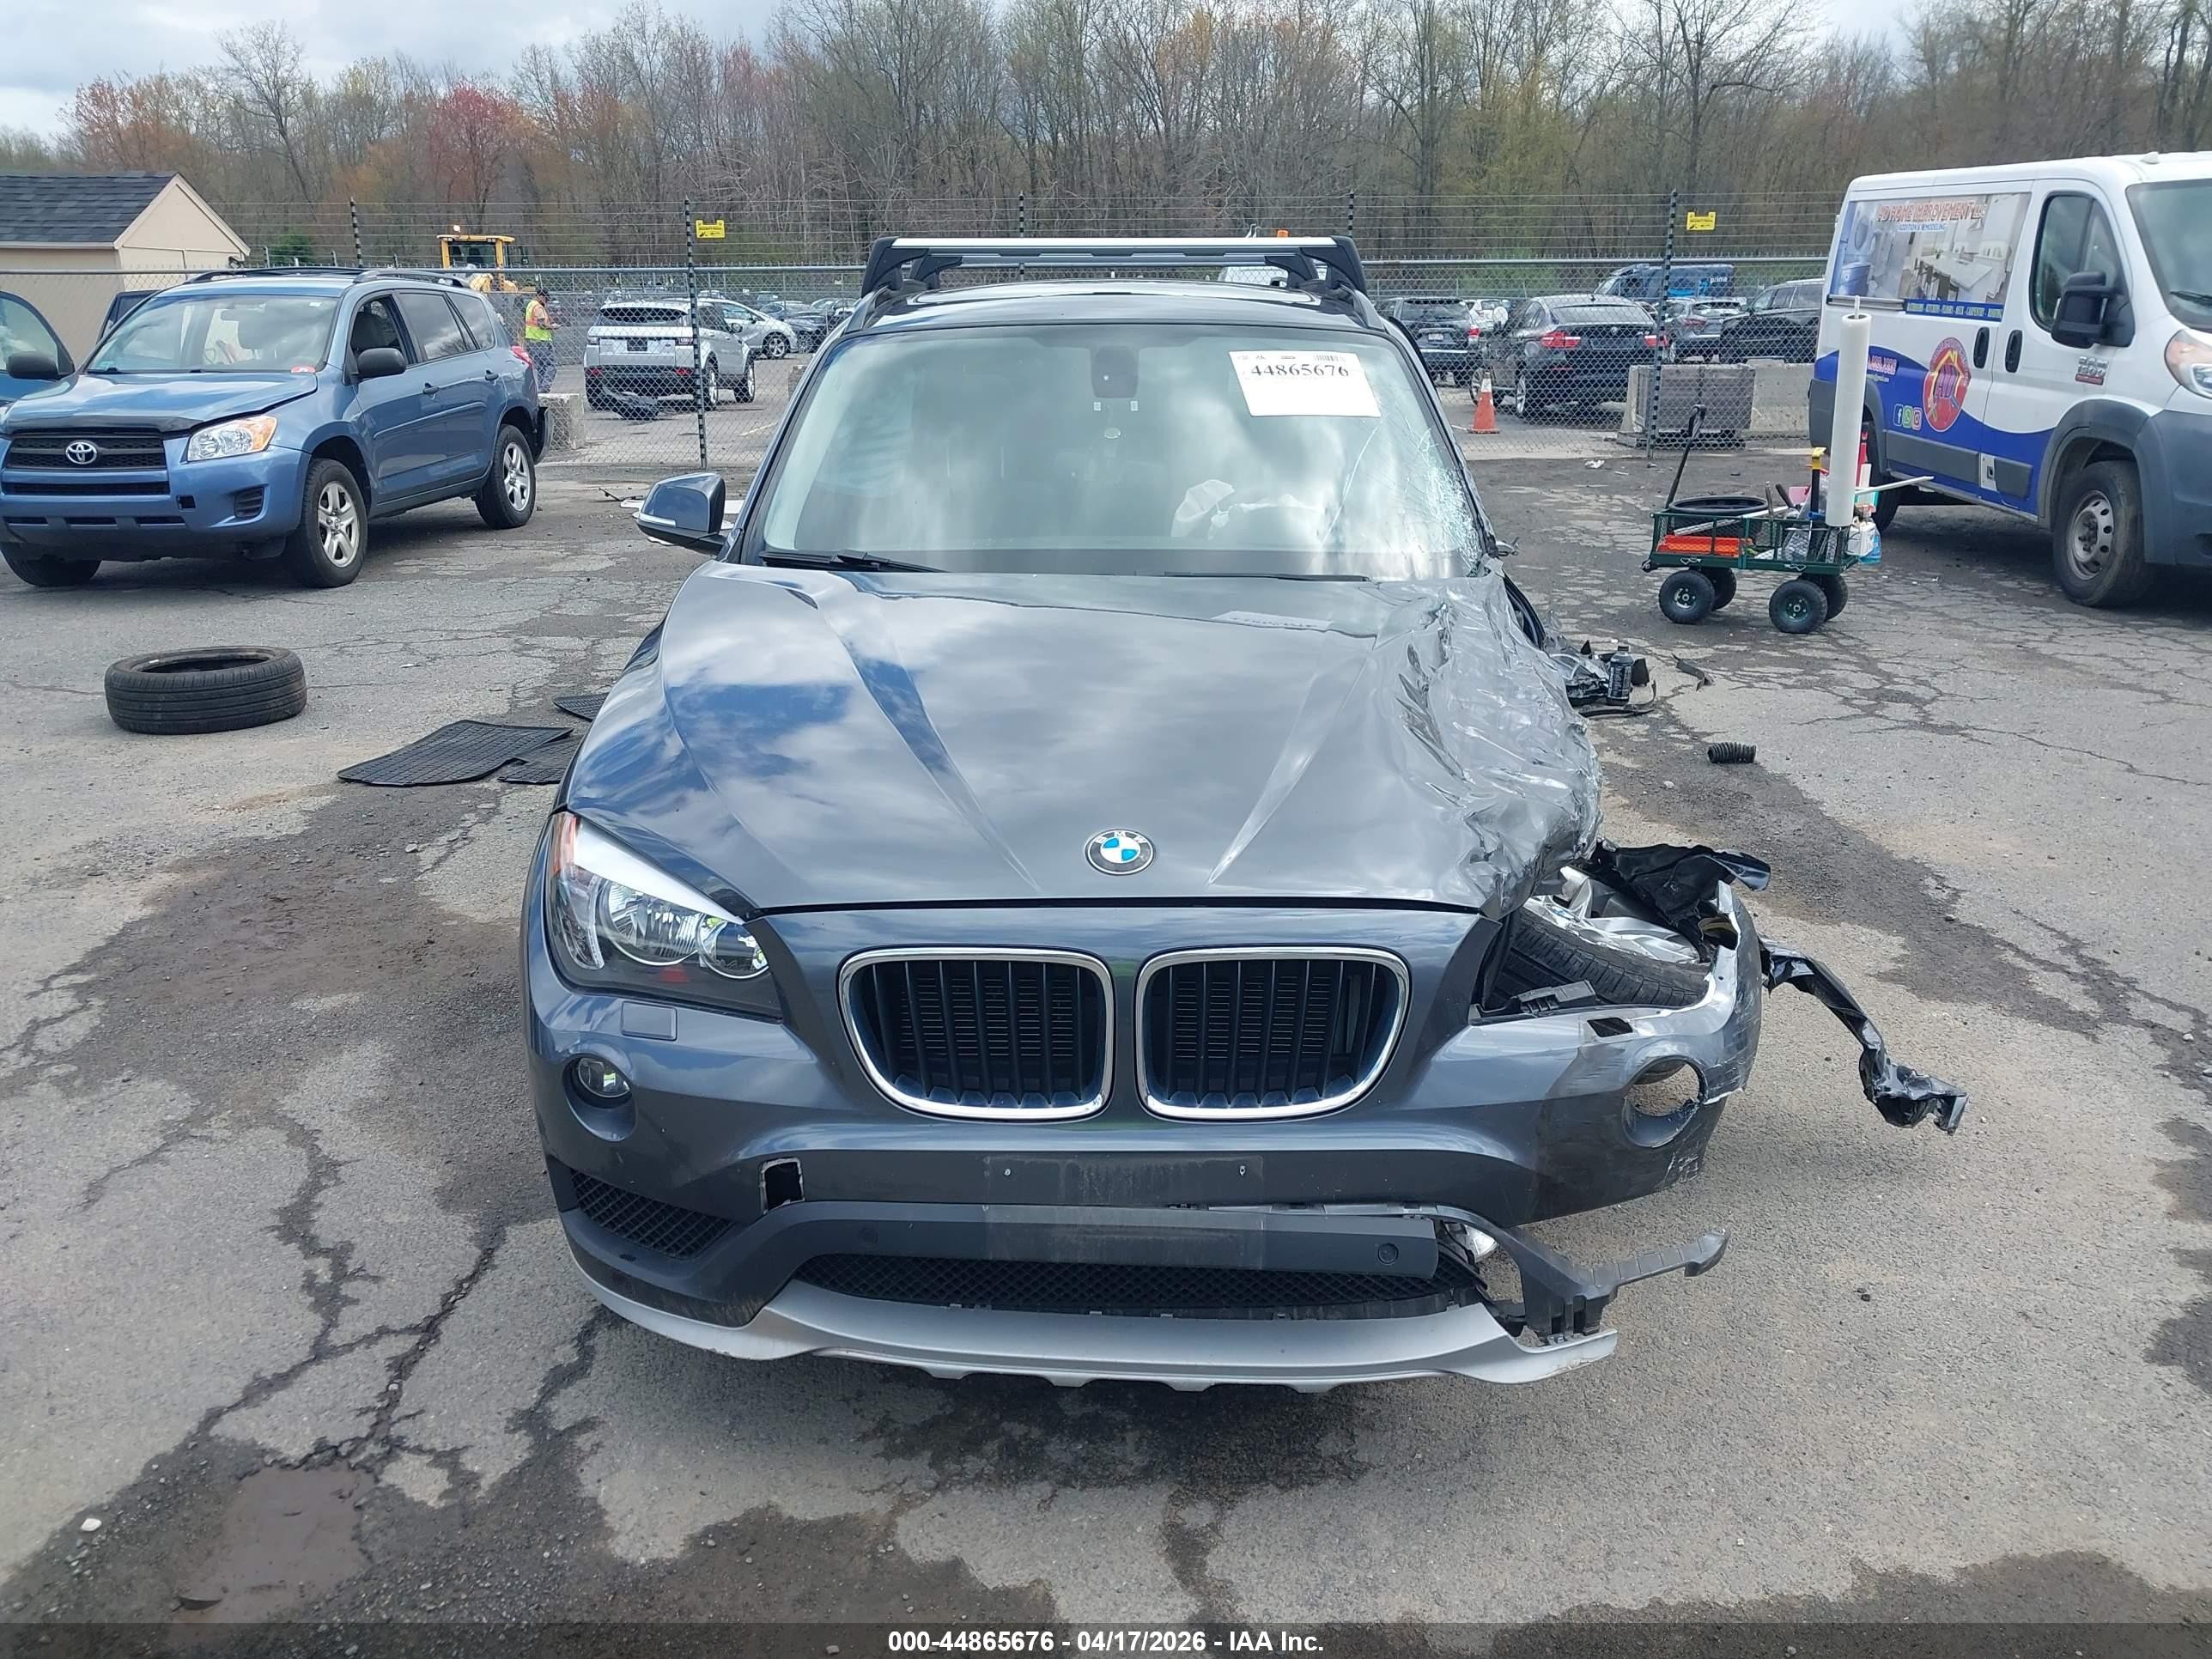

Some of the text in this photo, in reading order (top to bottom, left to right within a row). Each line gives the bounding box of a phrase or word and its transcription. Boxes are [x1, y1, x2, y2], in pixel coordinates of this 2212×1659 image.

[1890, 204, 1913, 222] HOME
[1913, 200, 1975, 221] IMPROVEMENT
[1710, 276, 1728, 285] prime
[1251, 363, 1349, 377] 44865676
